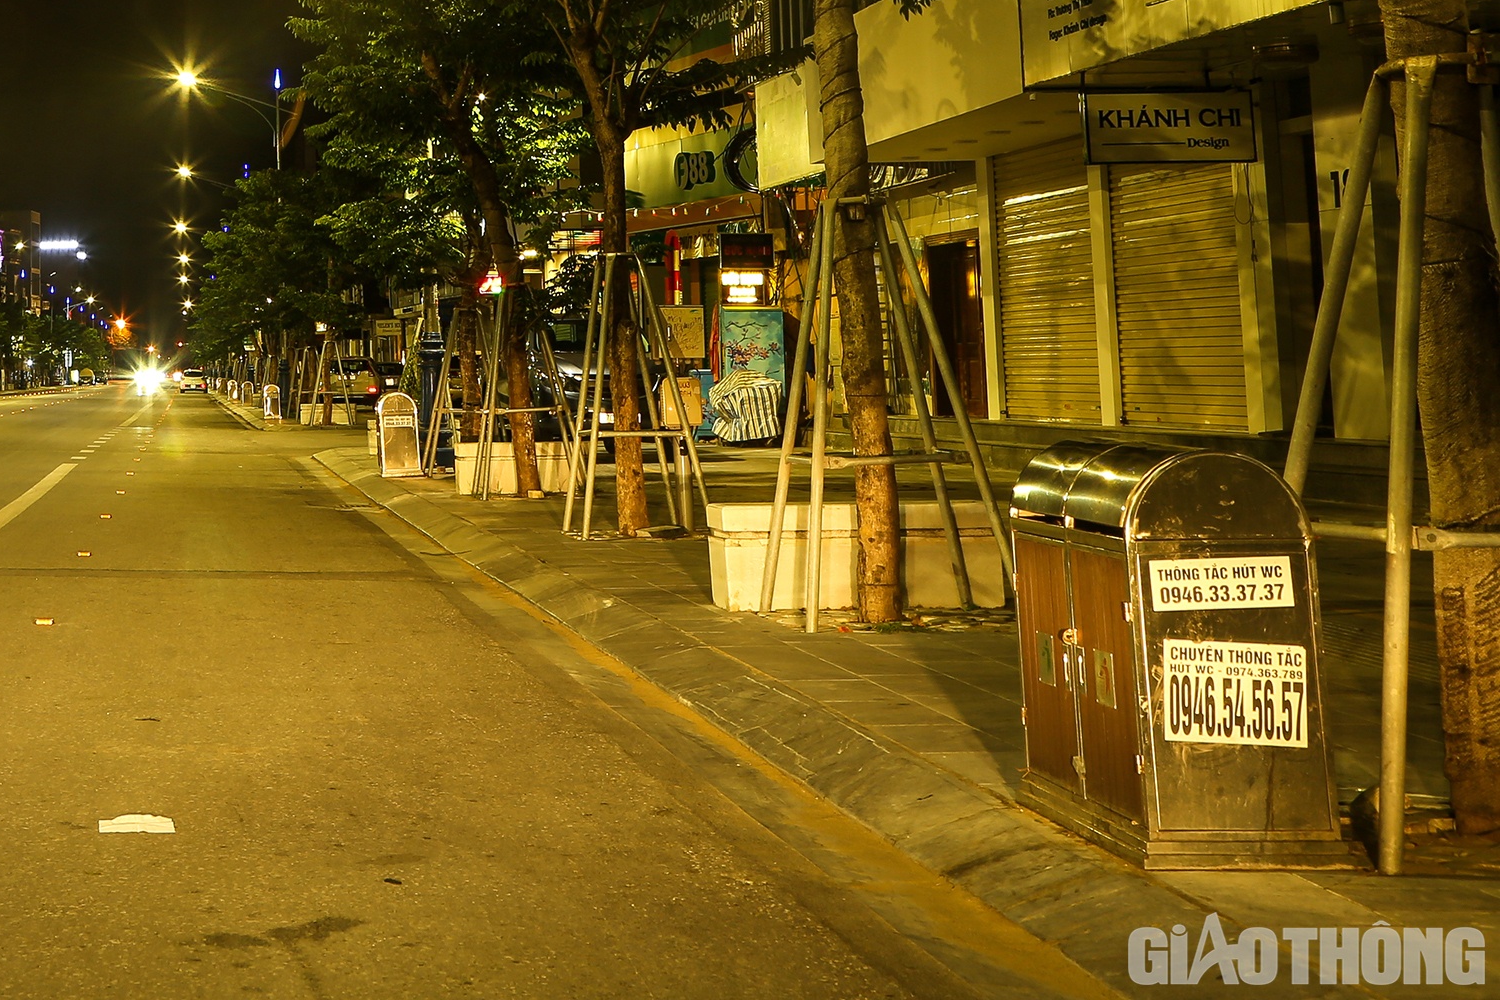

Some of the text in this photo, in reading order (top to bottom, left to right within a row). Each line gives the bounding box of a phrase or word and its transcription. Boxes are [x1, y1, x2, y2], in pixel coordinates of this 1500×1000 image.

[1099, 104, 1241, 128] KHÁNH CHI
[1187, 137, 1229, 149] Design
[1330, 169, 1350, 208] 1
[1157, 563, 1282, 581] THÔNG TẮC HÚT WC
[1160, 583, 1284, 604] 0946.33.37.37
[1170, 645, 1302, 667] CHUYÊN THÔNG TẮC
[1170, 662, 1191, 673] HÚT
[1196, 665, 1214, 674] WC
[1226, 666, 1303, 679] 0974.363.789
[1170, 674, 1304, 741] 0946.54.56.57
